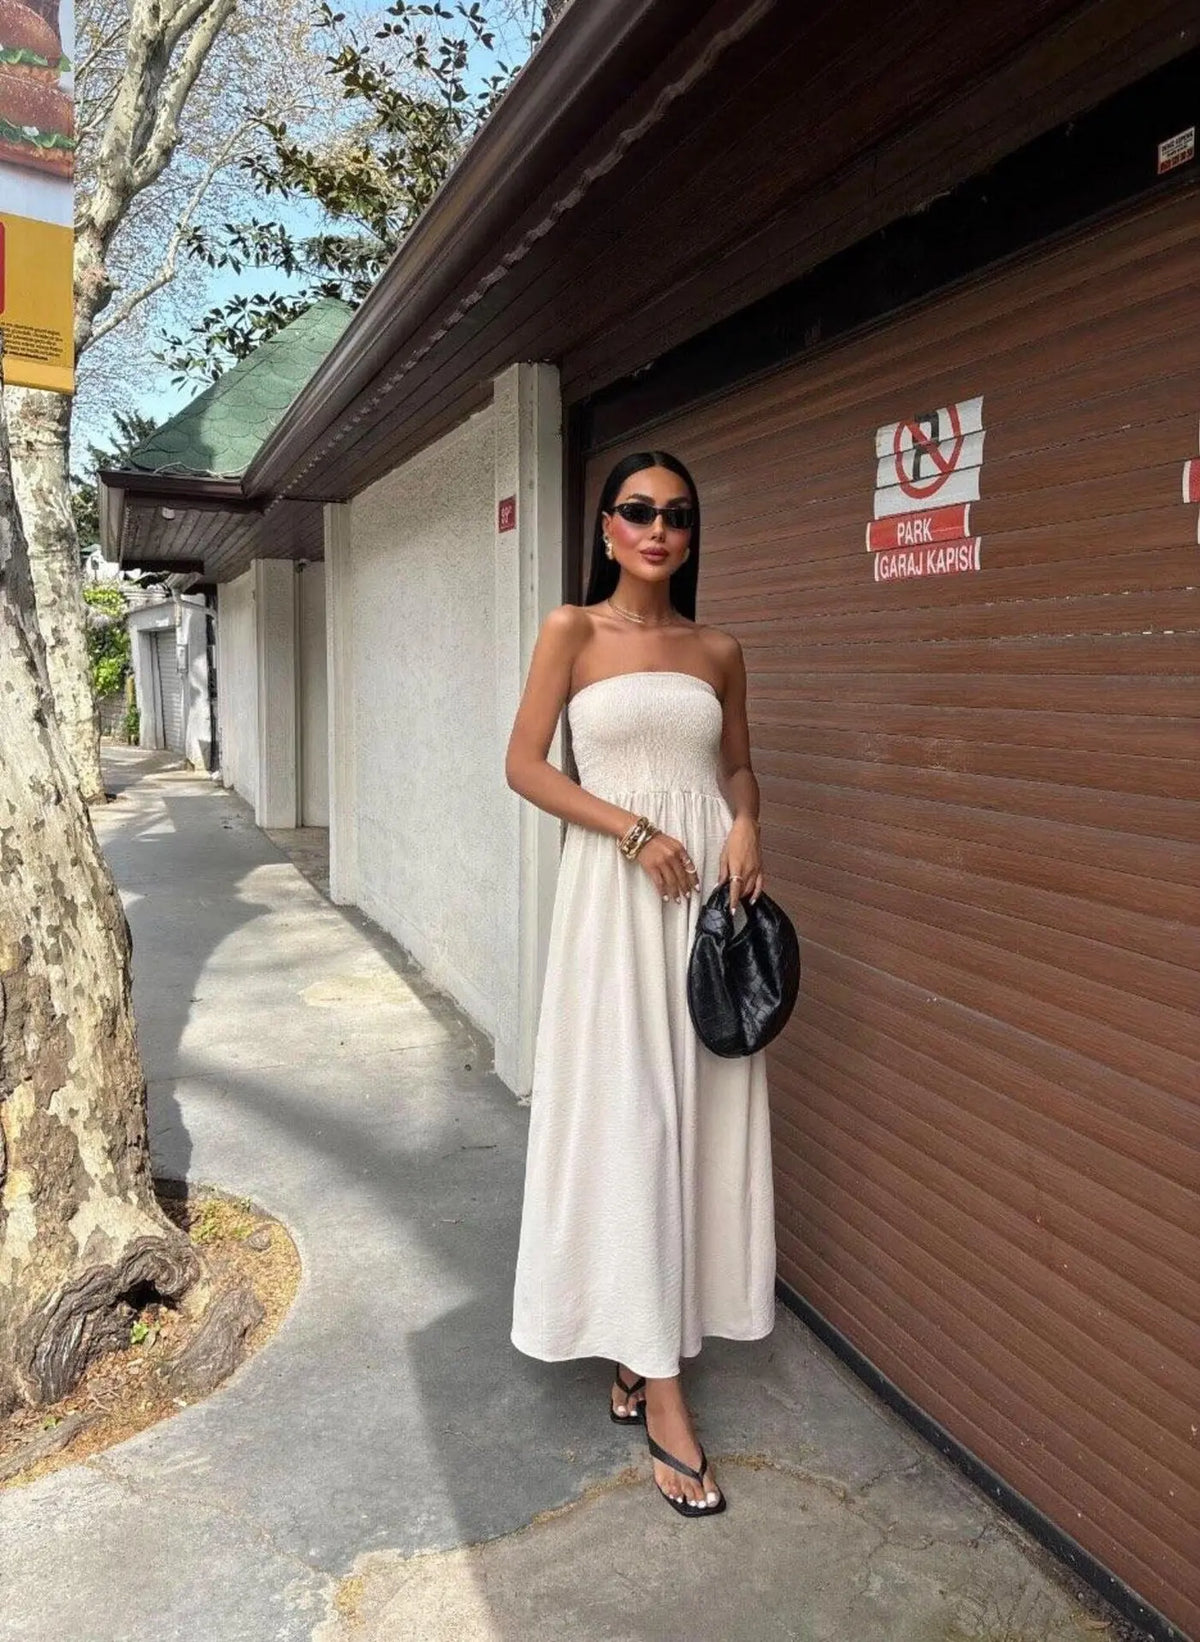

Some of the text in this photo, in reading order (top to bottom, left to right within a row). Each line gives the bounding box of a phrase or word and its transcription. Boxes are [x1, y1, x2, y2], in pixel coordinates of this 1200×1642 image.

[897, 518, 933, 546] PARK
[880, 546, 973, 579] GARAJ KAPISI
